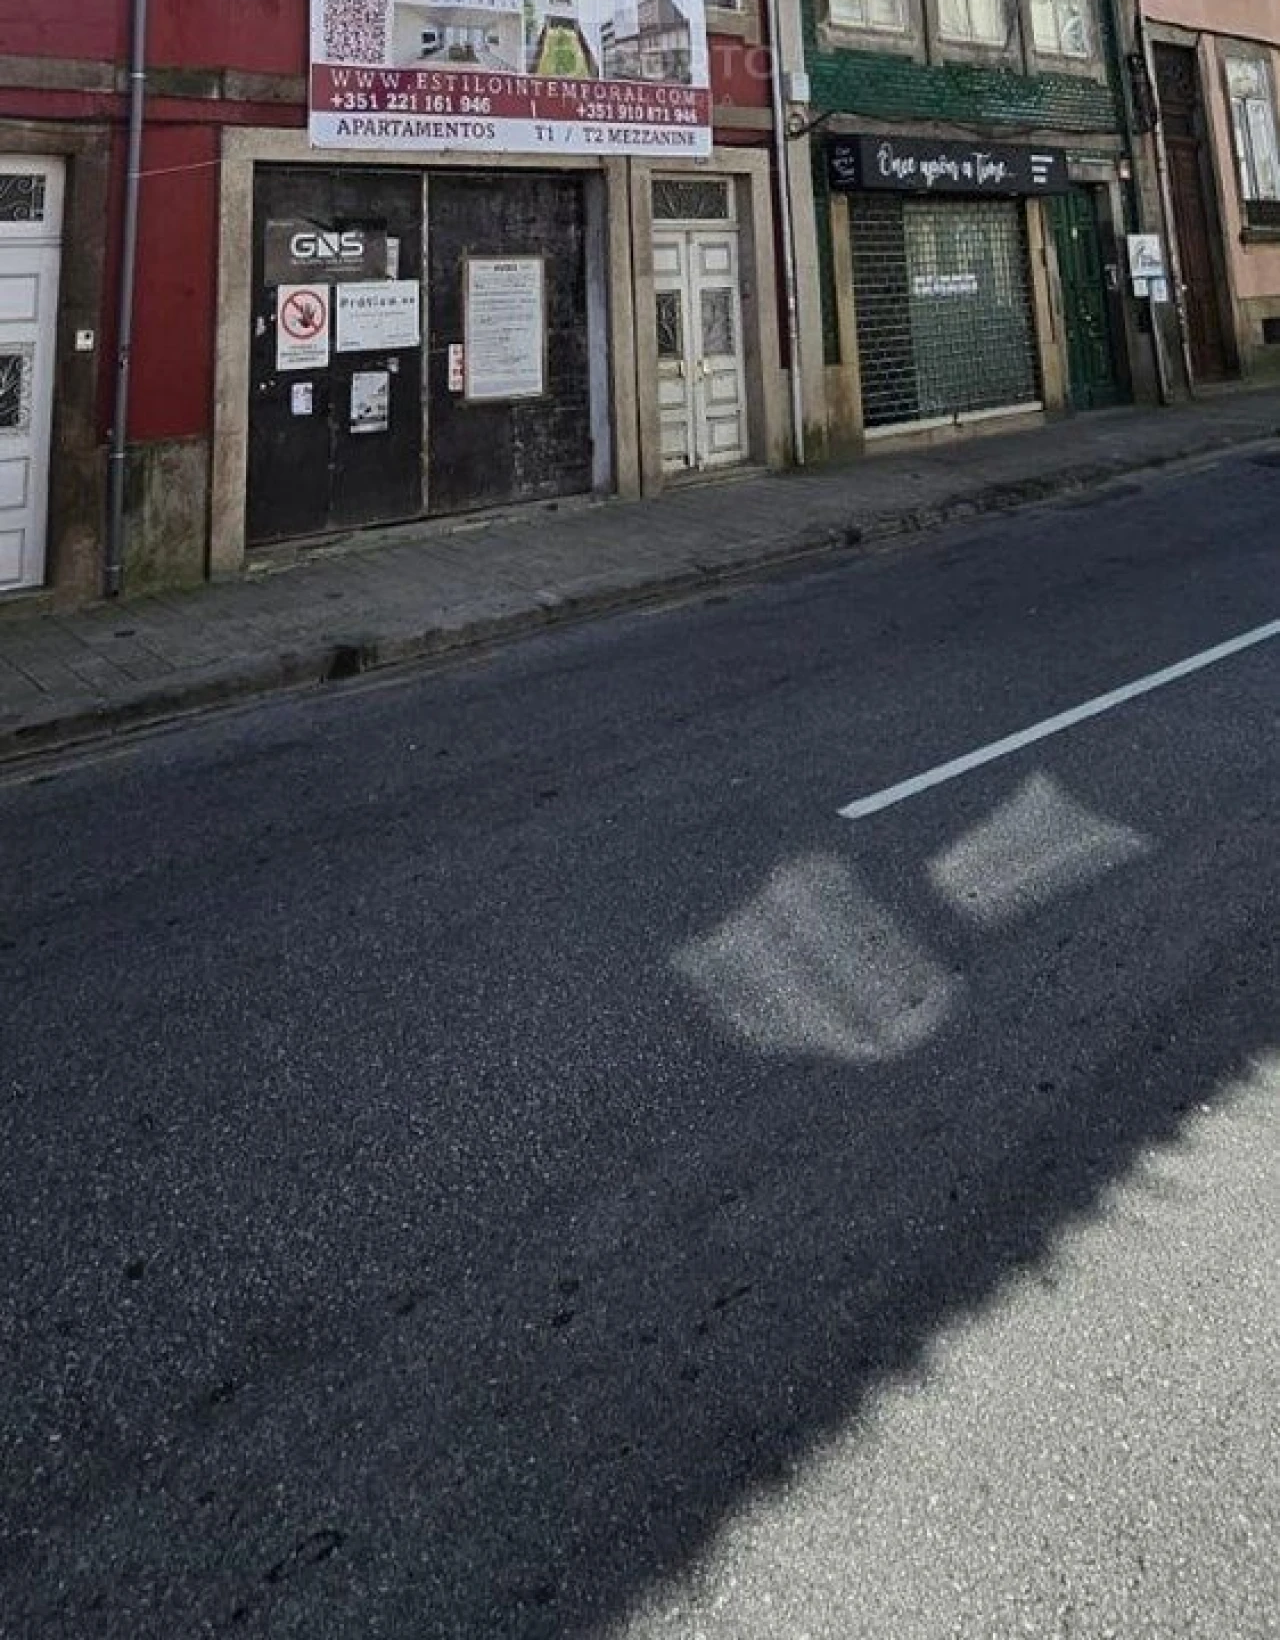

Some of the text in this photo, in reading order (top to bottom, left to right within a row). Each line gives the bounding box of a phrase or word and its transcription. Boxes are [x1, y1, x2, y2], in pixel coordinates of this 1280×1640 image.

[330, 91, 378, 110] +351
[386, 92, 417, 110] 221
[425, 95, 452, 112] 161
[459, 96, 491, 114] 946
[576, 102, 614, 120] +351
[619, 104, 643, 120] 910
[336, 118, 495, 139] APARTAMENTOS
[534, 125, 554, 142] T1
[582, 127, 604, 143] T2
[607, 129, 697, 147] MEZZANINE
